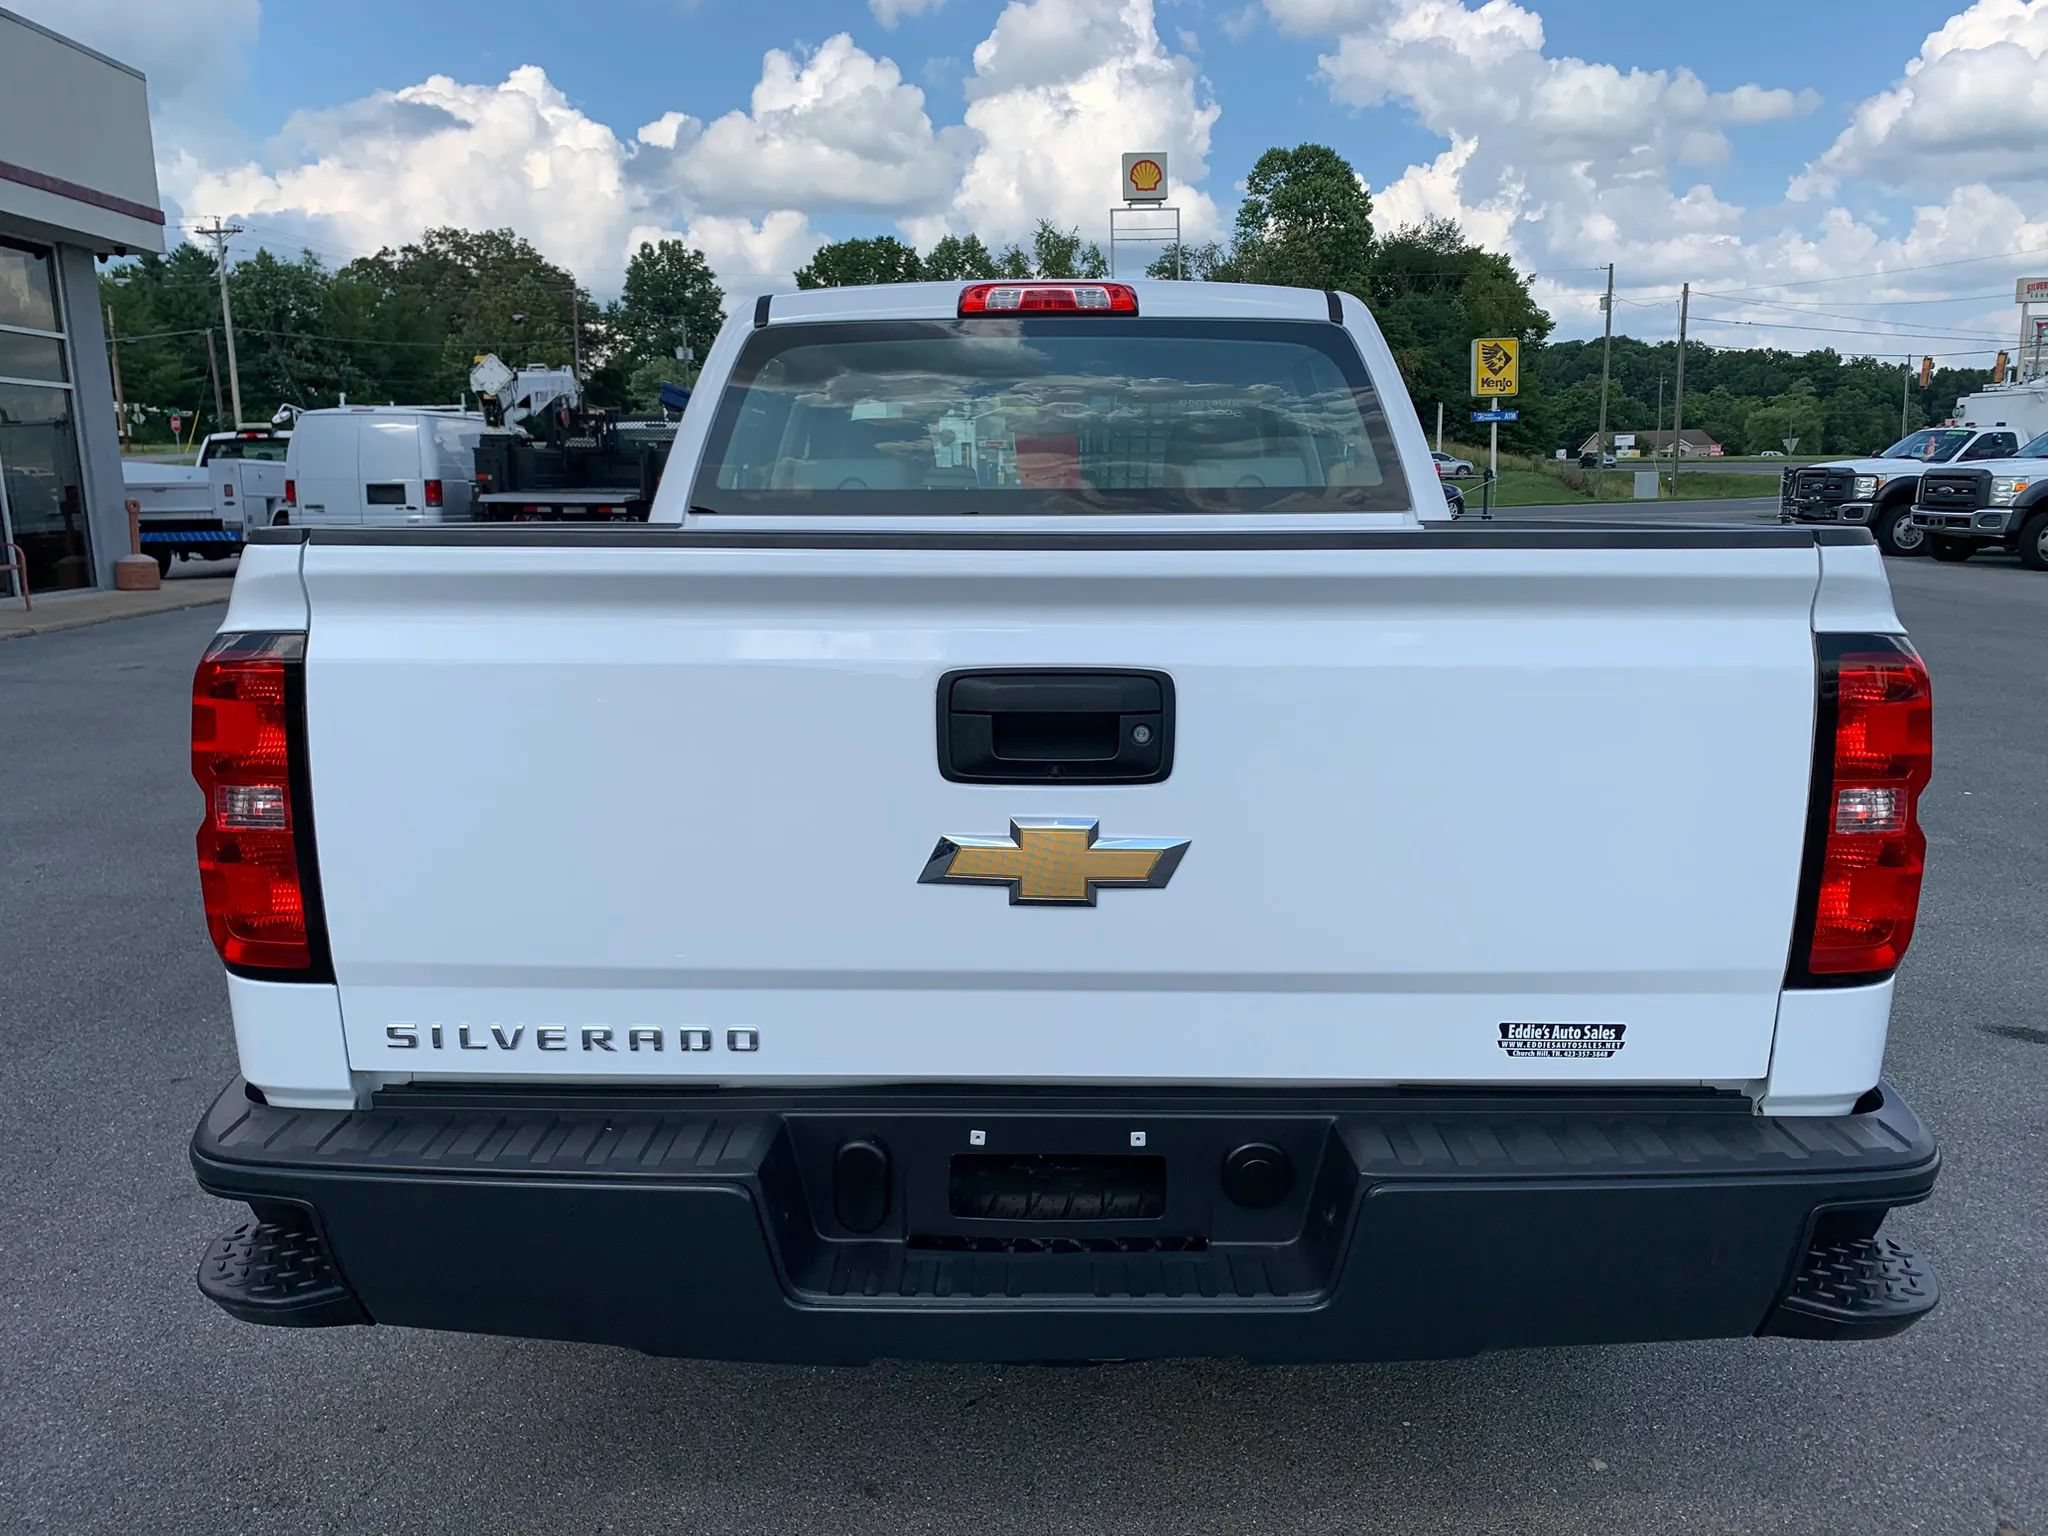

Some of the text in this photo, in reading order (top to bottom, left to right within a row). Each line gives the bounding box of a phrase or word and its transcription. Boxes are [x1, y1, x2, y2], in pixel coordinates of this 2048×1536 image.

[386, 1023, 761, 1052] SILVERADO
[1508, 1024, 1616, 1040] Eddie's Auto Sales
[1501, 1041, 1621, 1049] WWW.EDDIESAUTOSALES.NET
